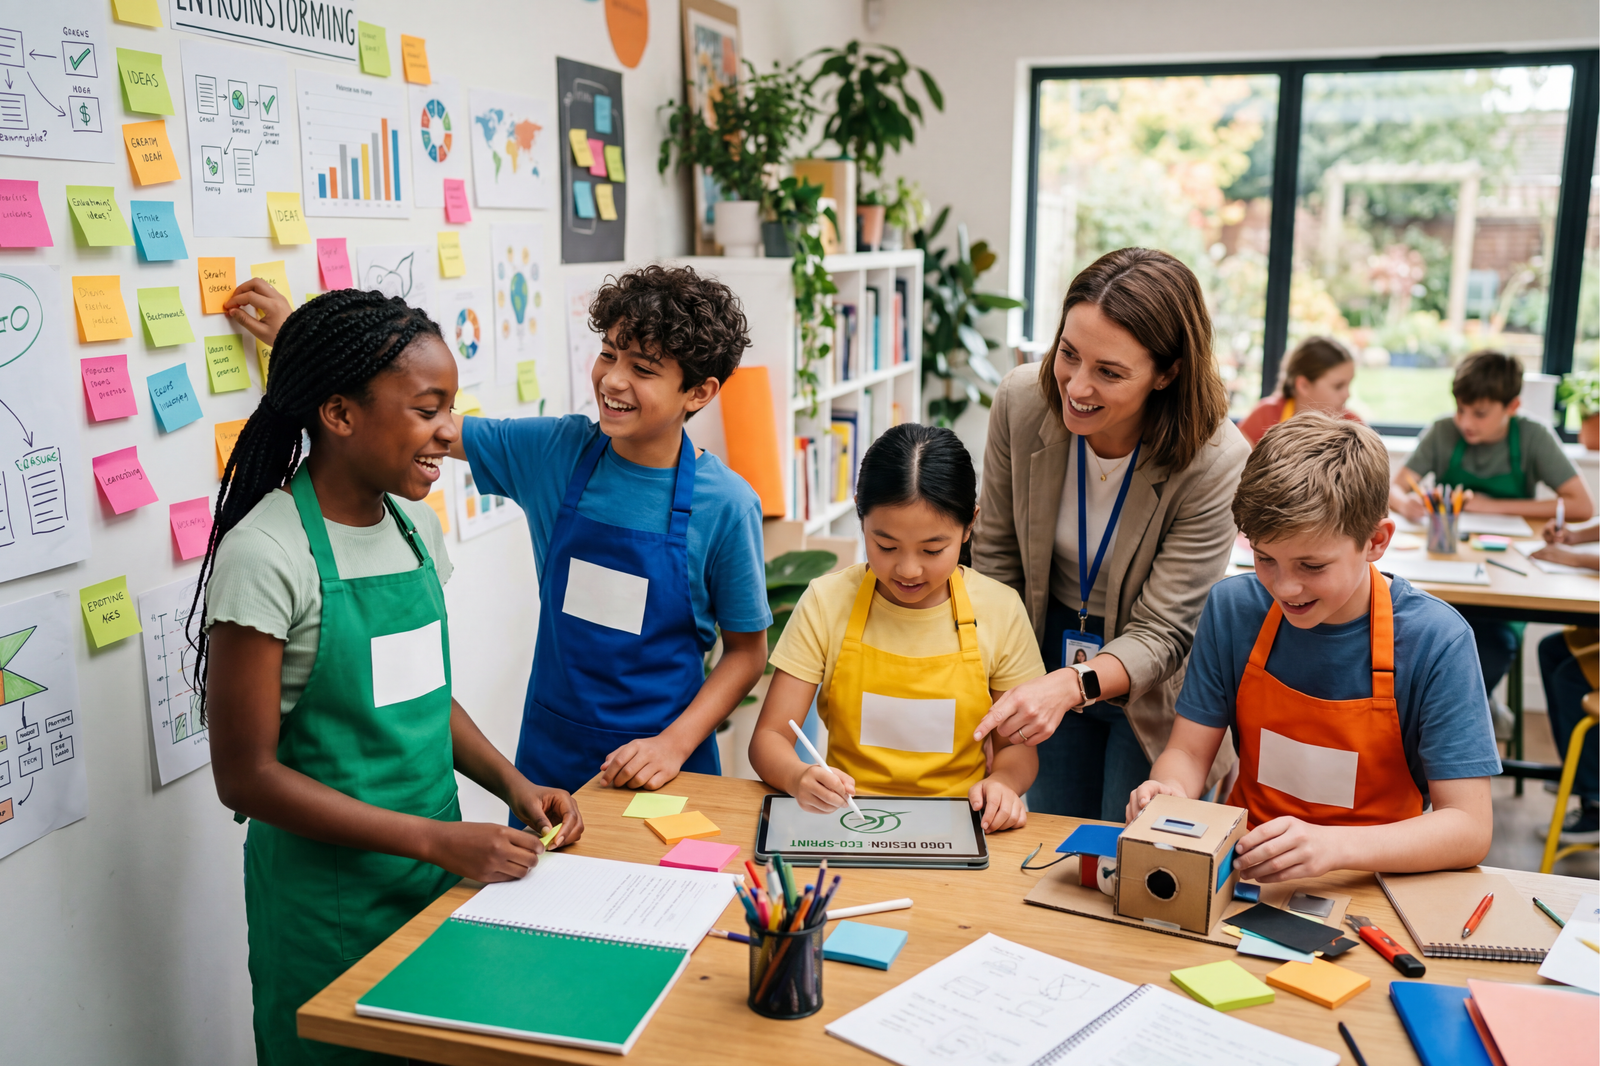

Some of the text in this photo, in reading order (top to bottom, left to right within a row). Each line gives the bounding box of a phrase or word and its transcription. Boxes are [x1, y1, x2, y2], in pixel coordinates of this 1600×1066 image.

[127, 69, 159, 87] IDEAS
[147, 229, 169, 239] ideas
[789, 839, 953, 850] LOGO DESIGN: ECO-SPRINT
